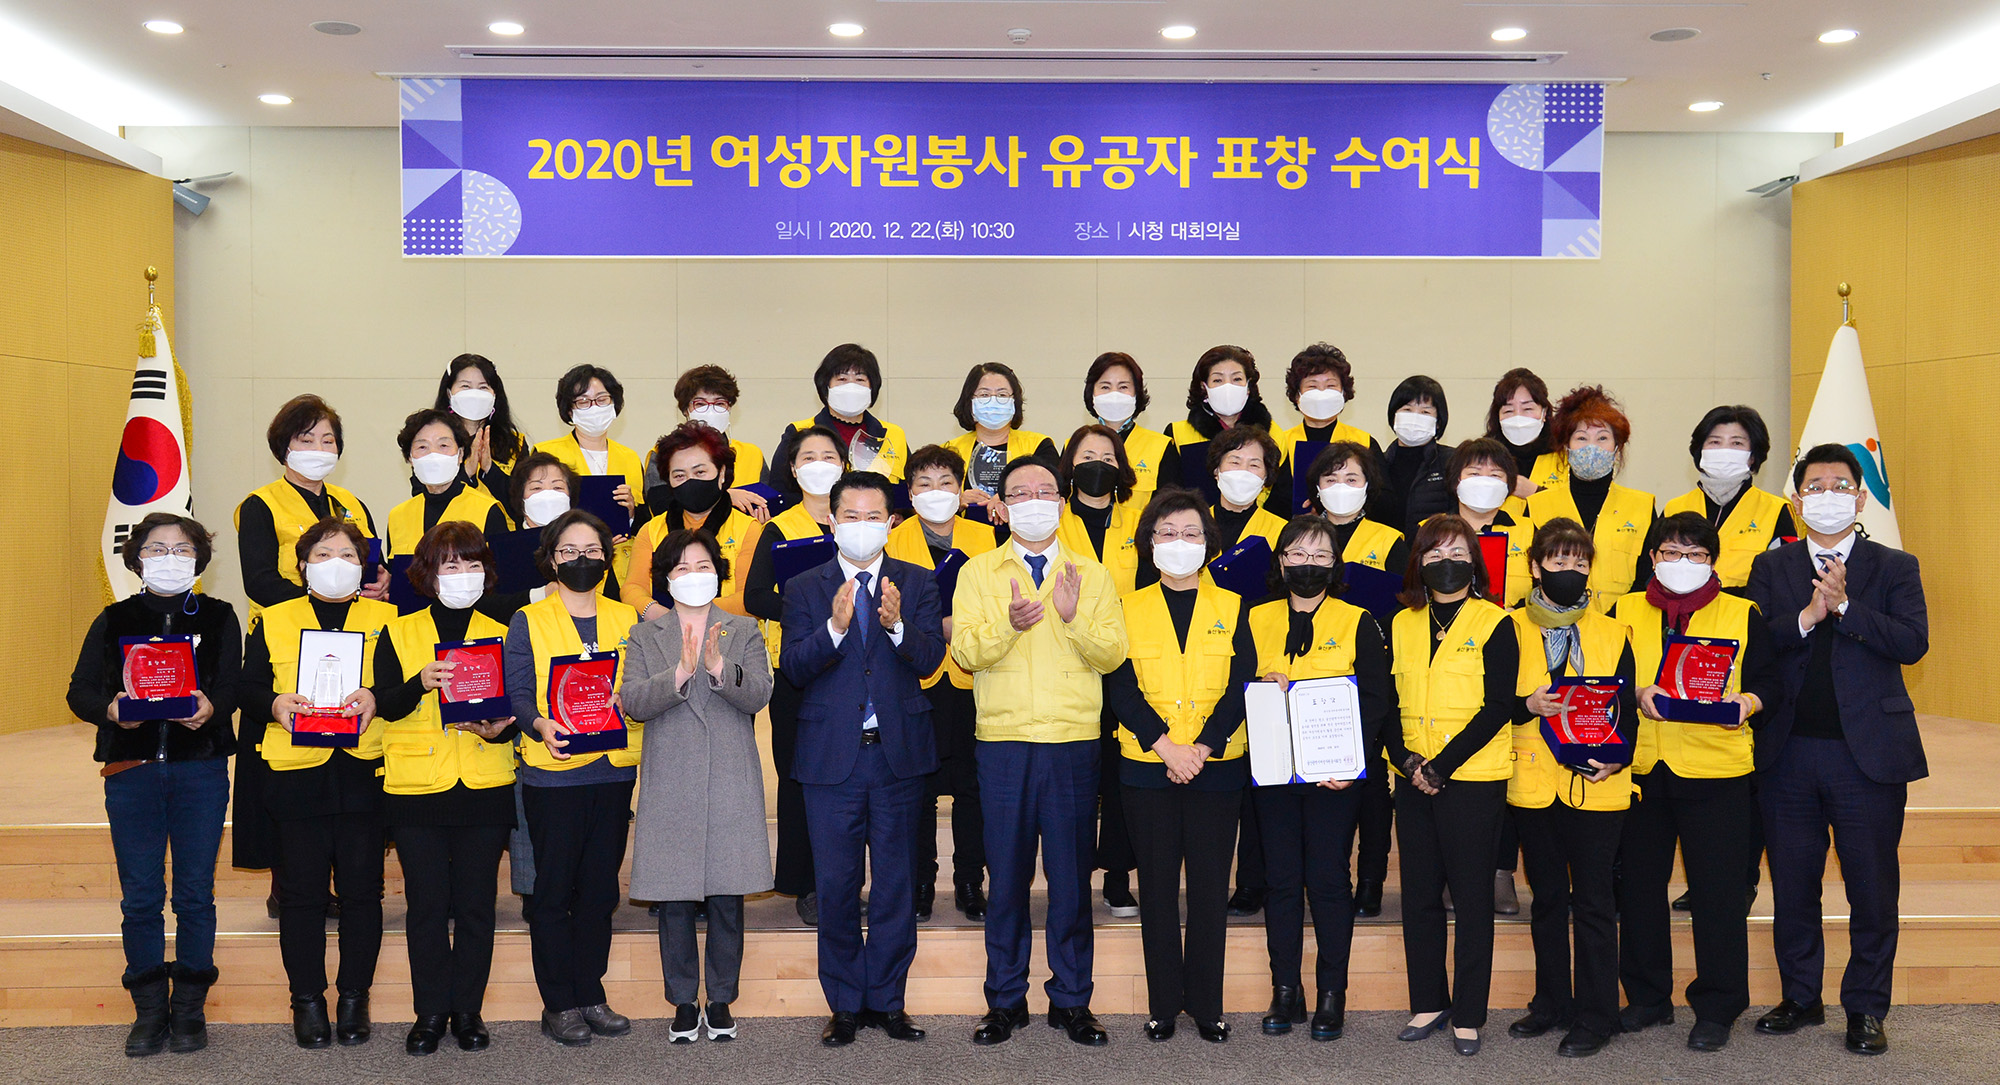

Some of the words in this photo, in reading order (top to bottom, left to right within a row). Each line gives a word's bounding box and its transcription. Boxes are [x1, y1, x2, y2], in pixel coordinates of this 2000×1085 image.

[528, 135, 693, 187] 2020년
[711, 135, 1027, 189] 여성자원봉사
[1042, 134, 1199, 190] 유공자
[1213, 135, 1317, 190] 표창
[1331, 137, 1480, 189] 수여식
[775, 220, 810, 240] 일시
[829, 221, 877, 240] 2020.
[882, 221, 905, 240] 12.
[970, 221, 1015, 240] 10:30
[1073, 221, 1110, 241] 장소
[1127, 220, 1164, 242] 시청
[1170, 220, 1241, 242] 대회의실
